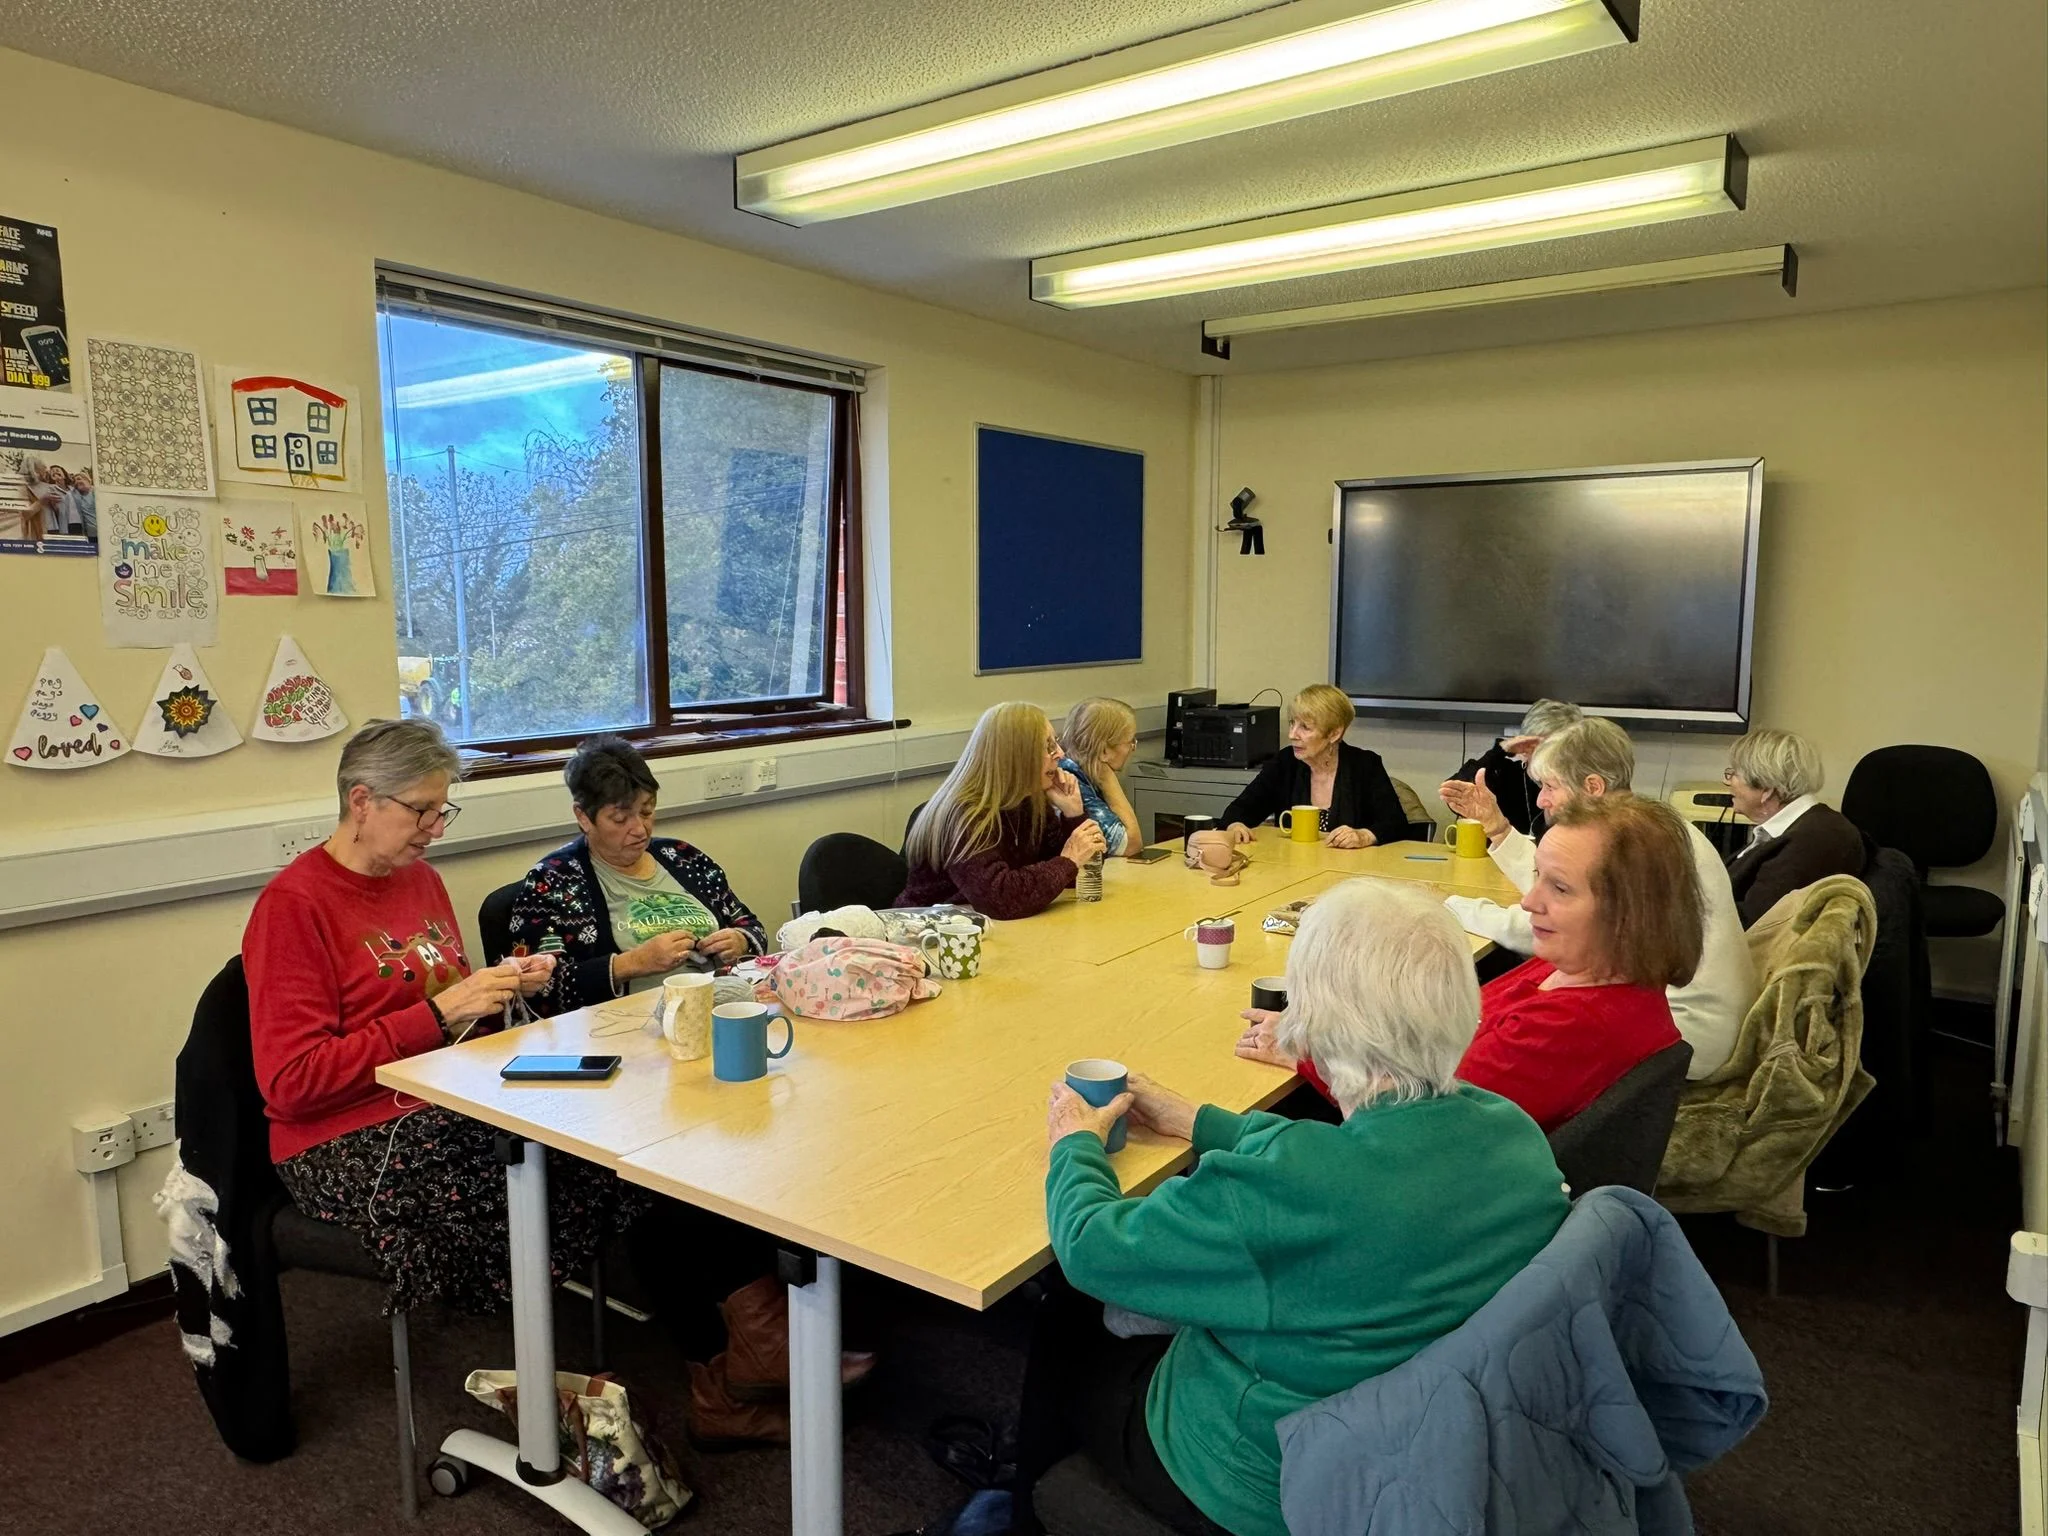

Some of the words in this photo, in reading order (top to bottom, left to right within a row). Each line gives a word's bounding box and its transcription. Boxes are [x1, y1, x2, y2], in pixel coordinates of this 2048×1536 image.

[36, 228, 53, 238] NHS
[0, 259, 29, 276] ARMS
[0, 301, 39, 318] SPEECH
[3, 347, 29, 361] TIME
[6, 371, 30, 385] DIAL
[32, 373, 51, 387] 999
[9, 432, 39, 441] Hearing
[121, 538, 189, 561] make
[133, 559, 173, 579] me
[305, 685, 321, 704] KIND
[302, 707, 314, 716] TO
[38, 732, 102, 759] loved
